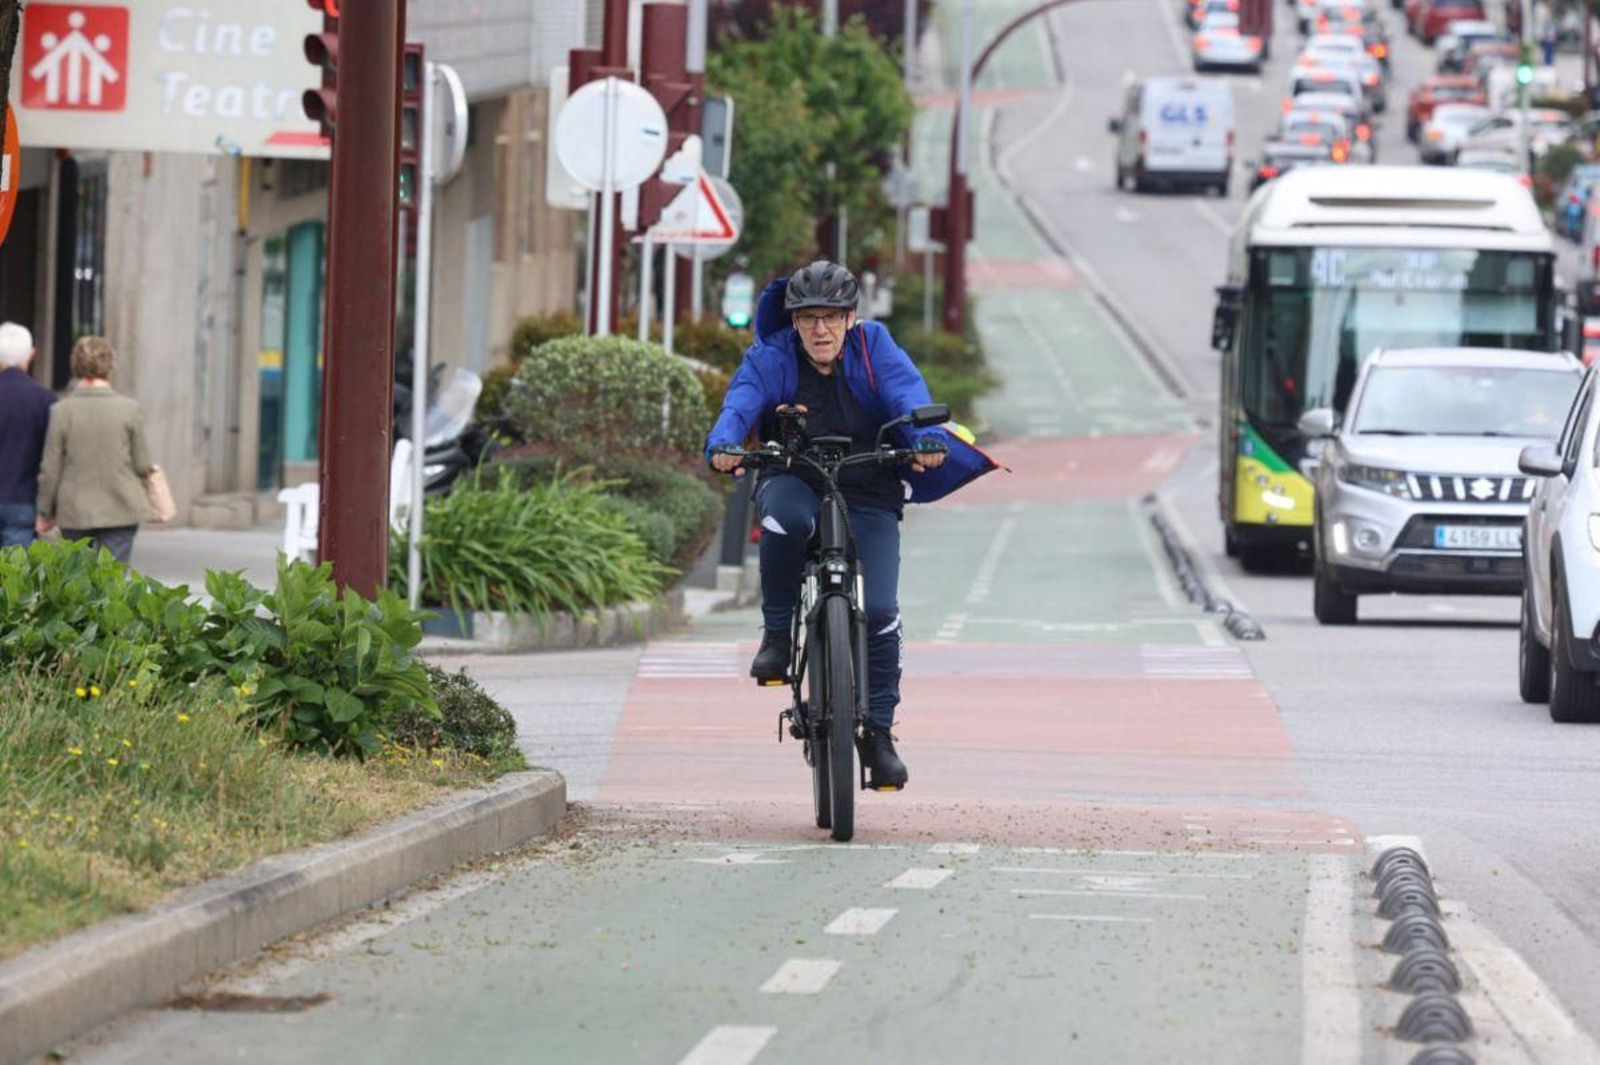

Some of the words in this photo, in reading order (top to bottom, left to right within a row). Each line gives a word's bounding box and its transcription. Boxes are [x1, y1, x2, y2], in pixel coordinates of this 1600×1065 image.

[158, 7, 277, 57] Cine
[158, 71, 304, 120] Teatr
[1160, 104, 1208, 128] GLS
[1449, 529, 1490, 546] 4159
